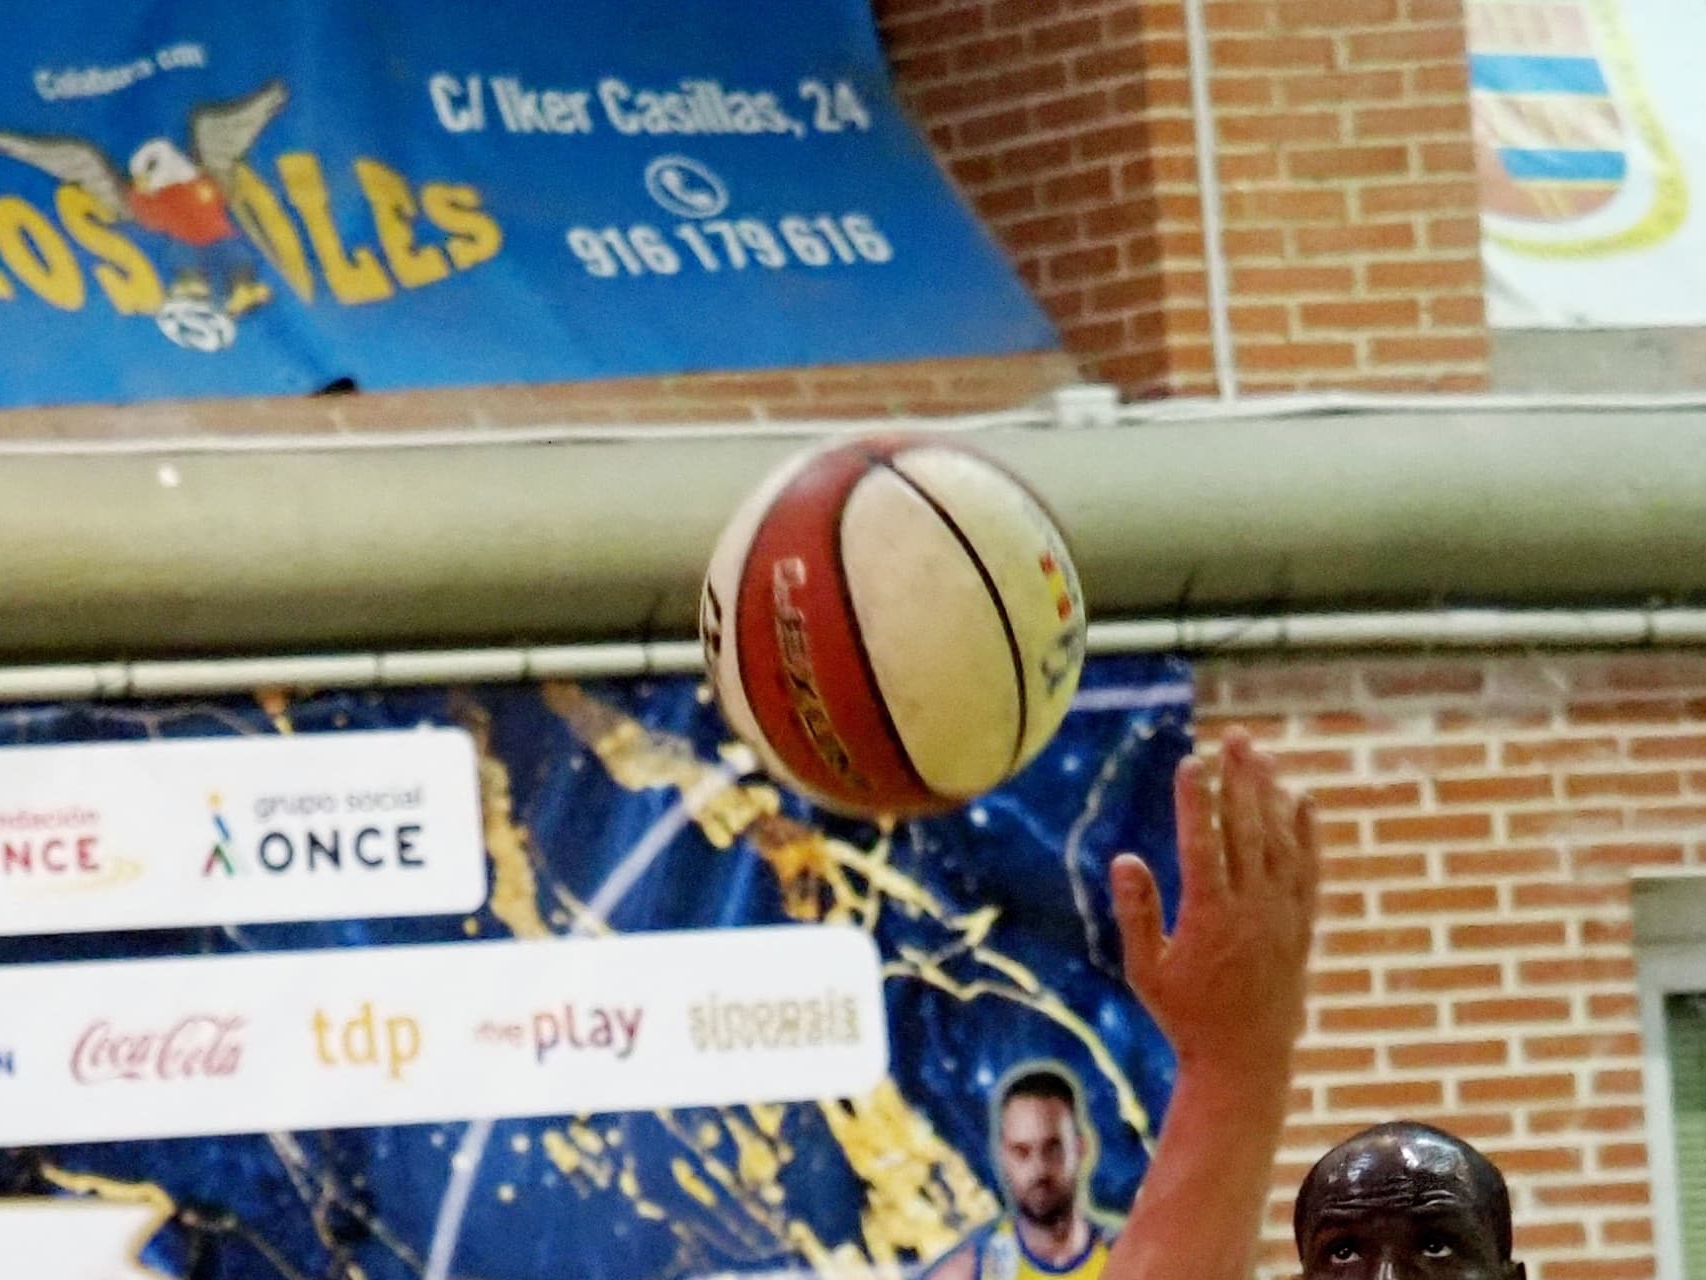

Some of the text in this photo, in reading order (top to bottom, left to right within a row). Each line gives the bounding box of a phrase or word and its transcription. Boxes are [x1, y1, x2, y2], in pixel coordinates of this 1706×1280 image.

[428, 74, 873, 138] C/ Iker Casillas, 24
[567, 212, 895, 278] 916 179 616
[257, 824, 427, 872] ONCE
[313, 1004, 421, 1078] tdp
